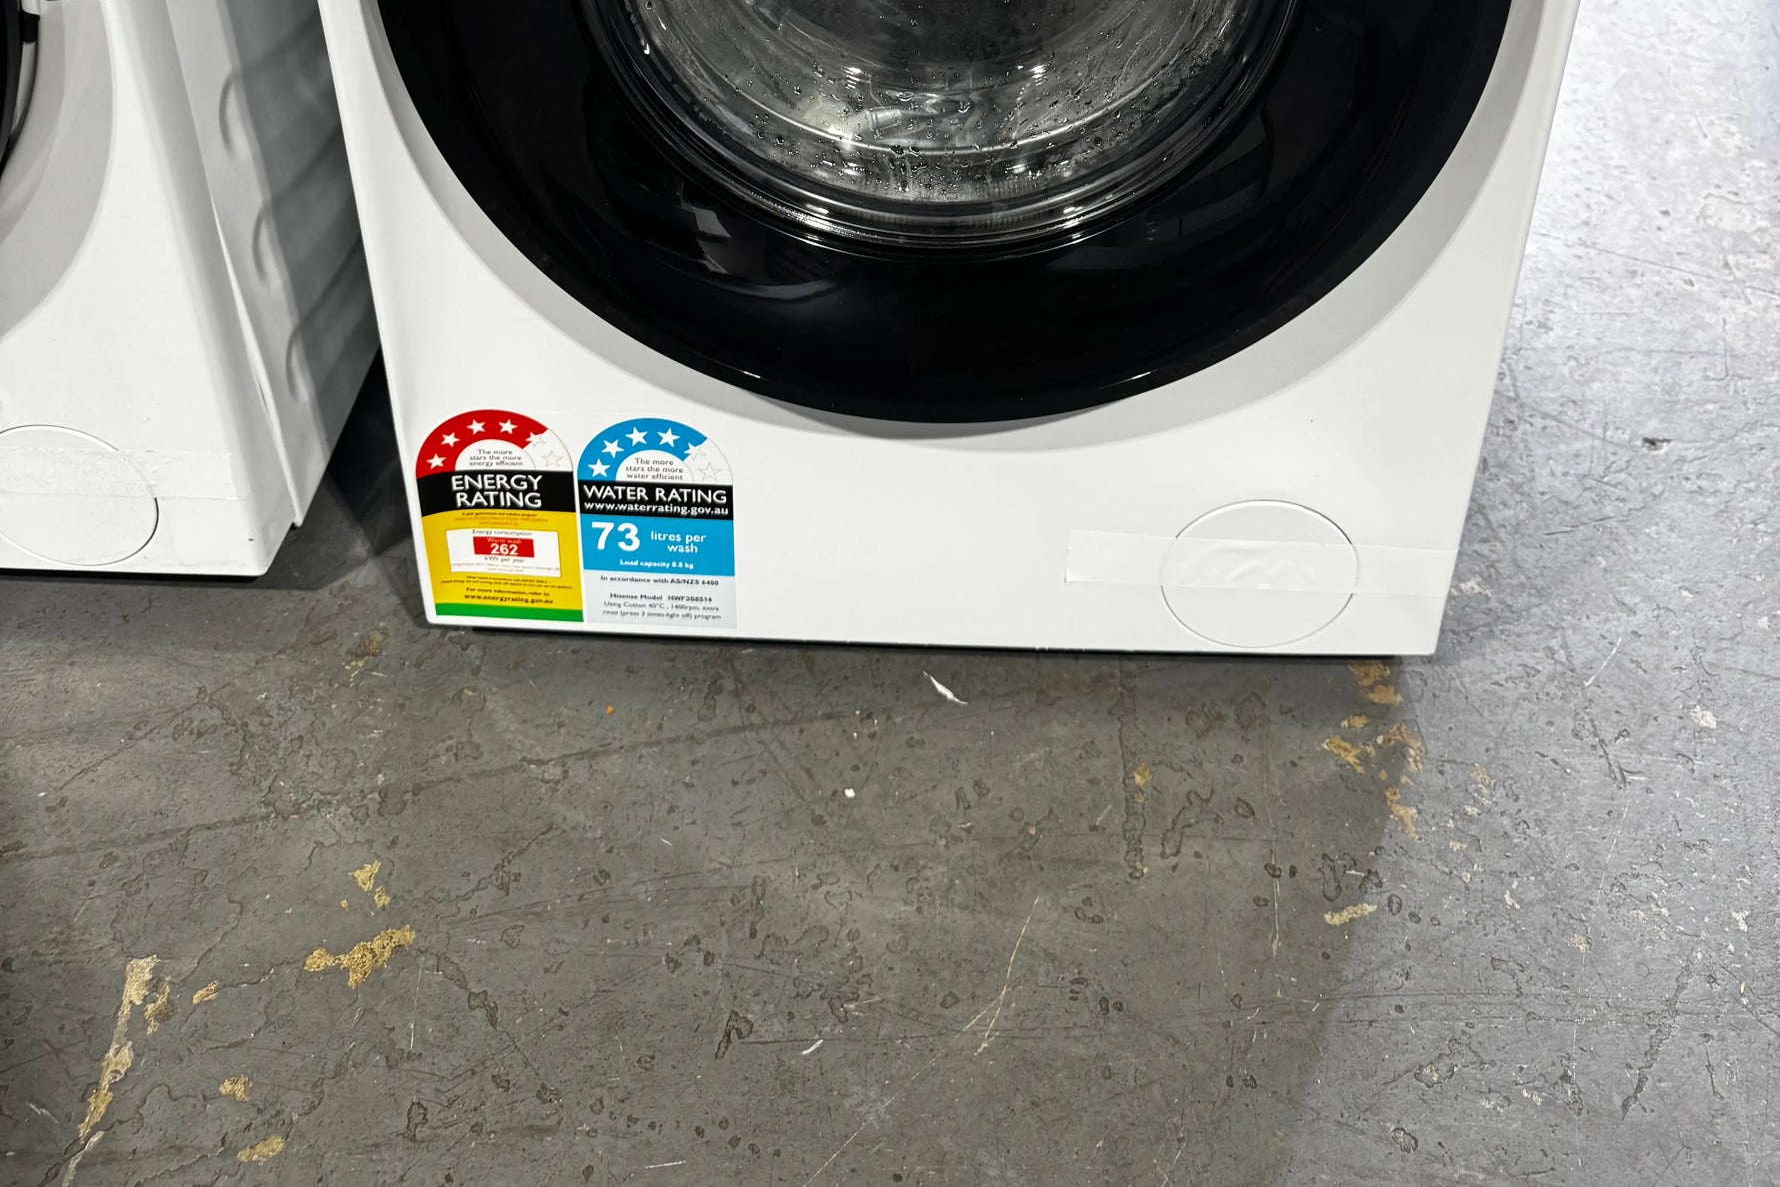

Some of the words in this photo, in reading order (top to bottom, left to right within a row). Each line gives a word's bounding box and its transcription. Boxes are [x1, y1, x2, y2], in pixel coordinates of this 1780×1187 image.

[451, 474, 542, 492] ENERGY
[456, 491, 542, 508] RATING
[584, 484, 648, 501] WATER
[656, 488, 728, 504] RATING
[584, 502, 728, 516] www.waterrating.gov.au
[592, 522, 640, 552] 73
[650, 530, 682, 542] litres
[686, 534, 706, 544] per
[490, 544, 518, 556] 262
[667, 544, 698, 553] wash
[640, 560, 670, 569] capacity
